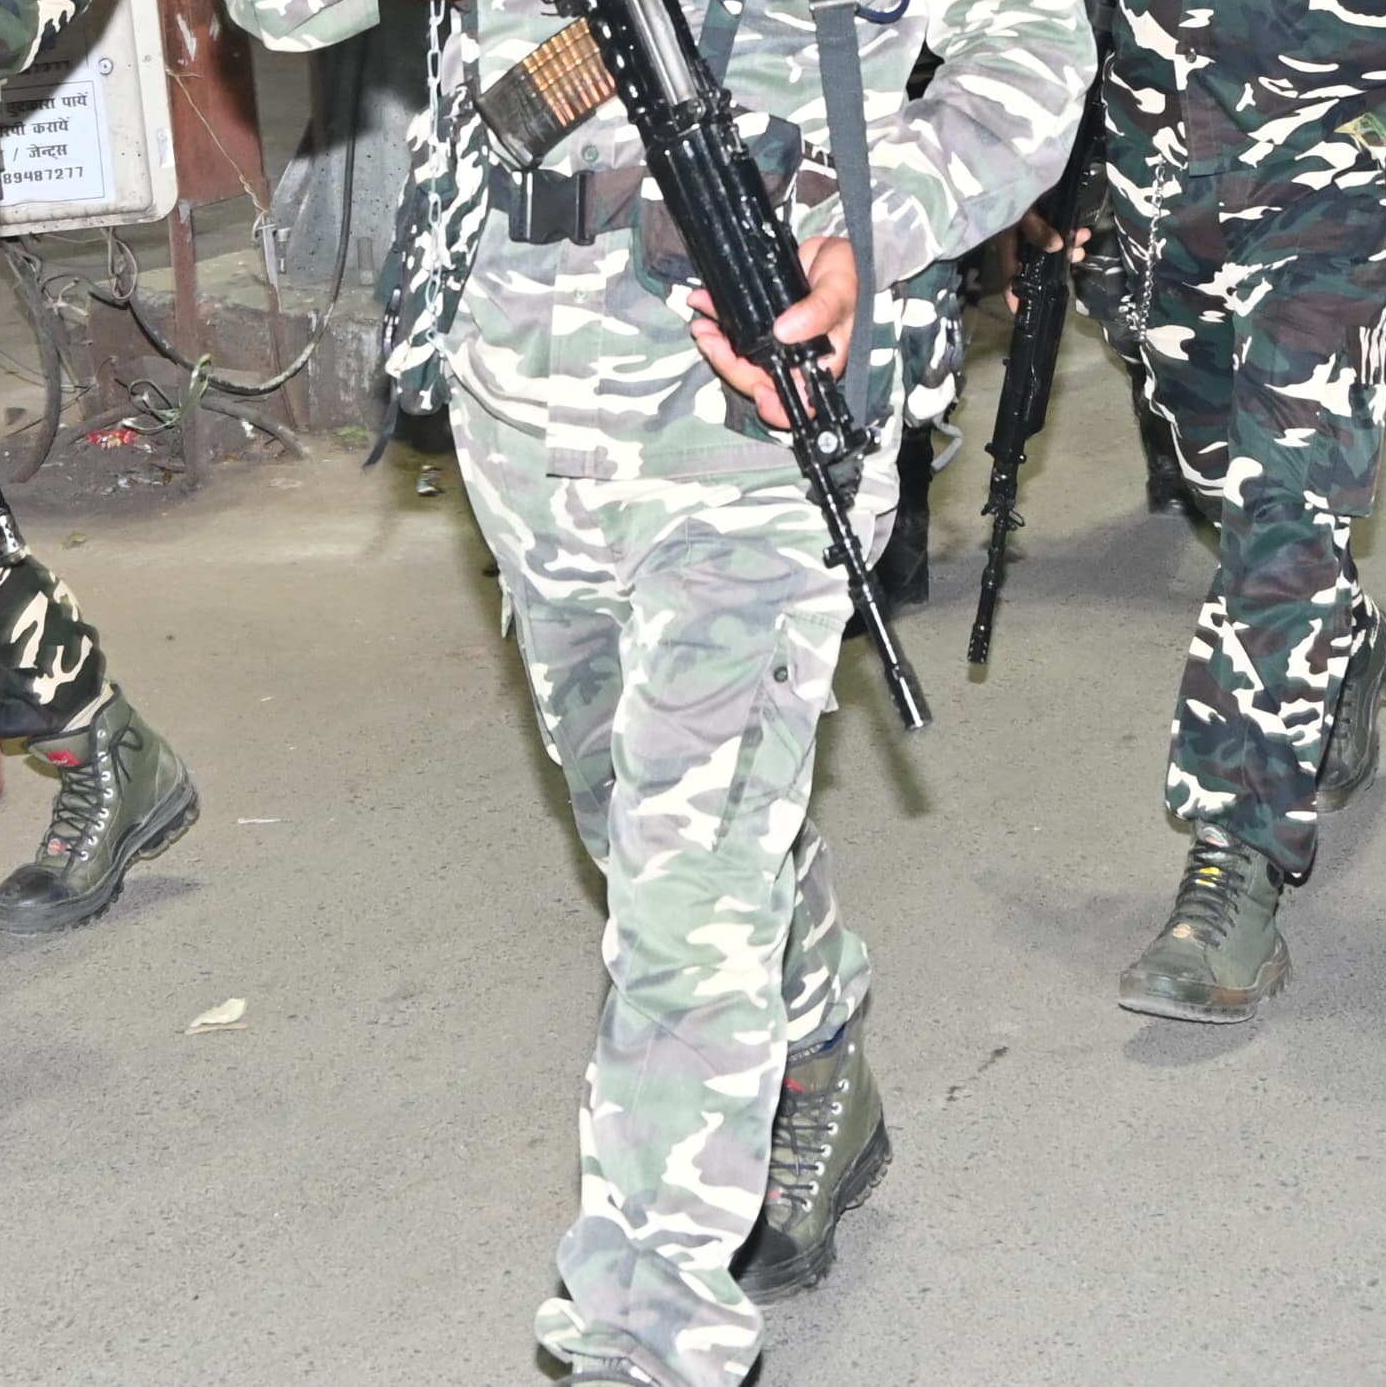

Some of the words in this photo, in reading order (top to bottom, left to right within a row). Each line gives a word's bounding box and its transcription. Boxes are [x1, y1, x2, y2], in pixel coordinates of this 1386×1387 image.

[61, 91, 89, 107] पायें
[32, 116, 69, 135] करायें
[27, 143, 69, 160] जेन्ट्स
[2, 165, 84, 185] 89487277
